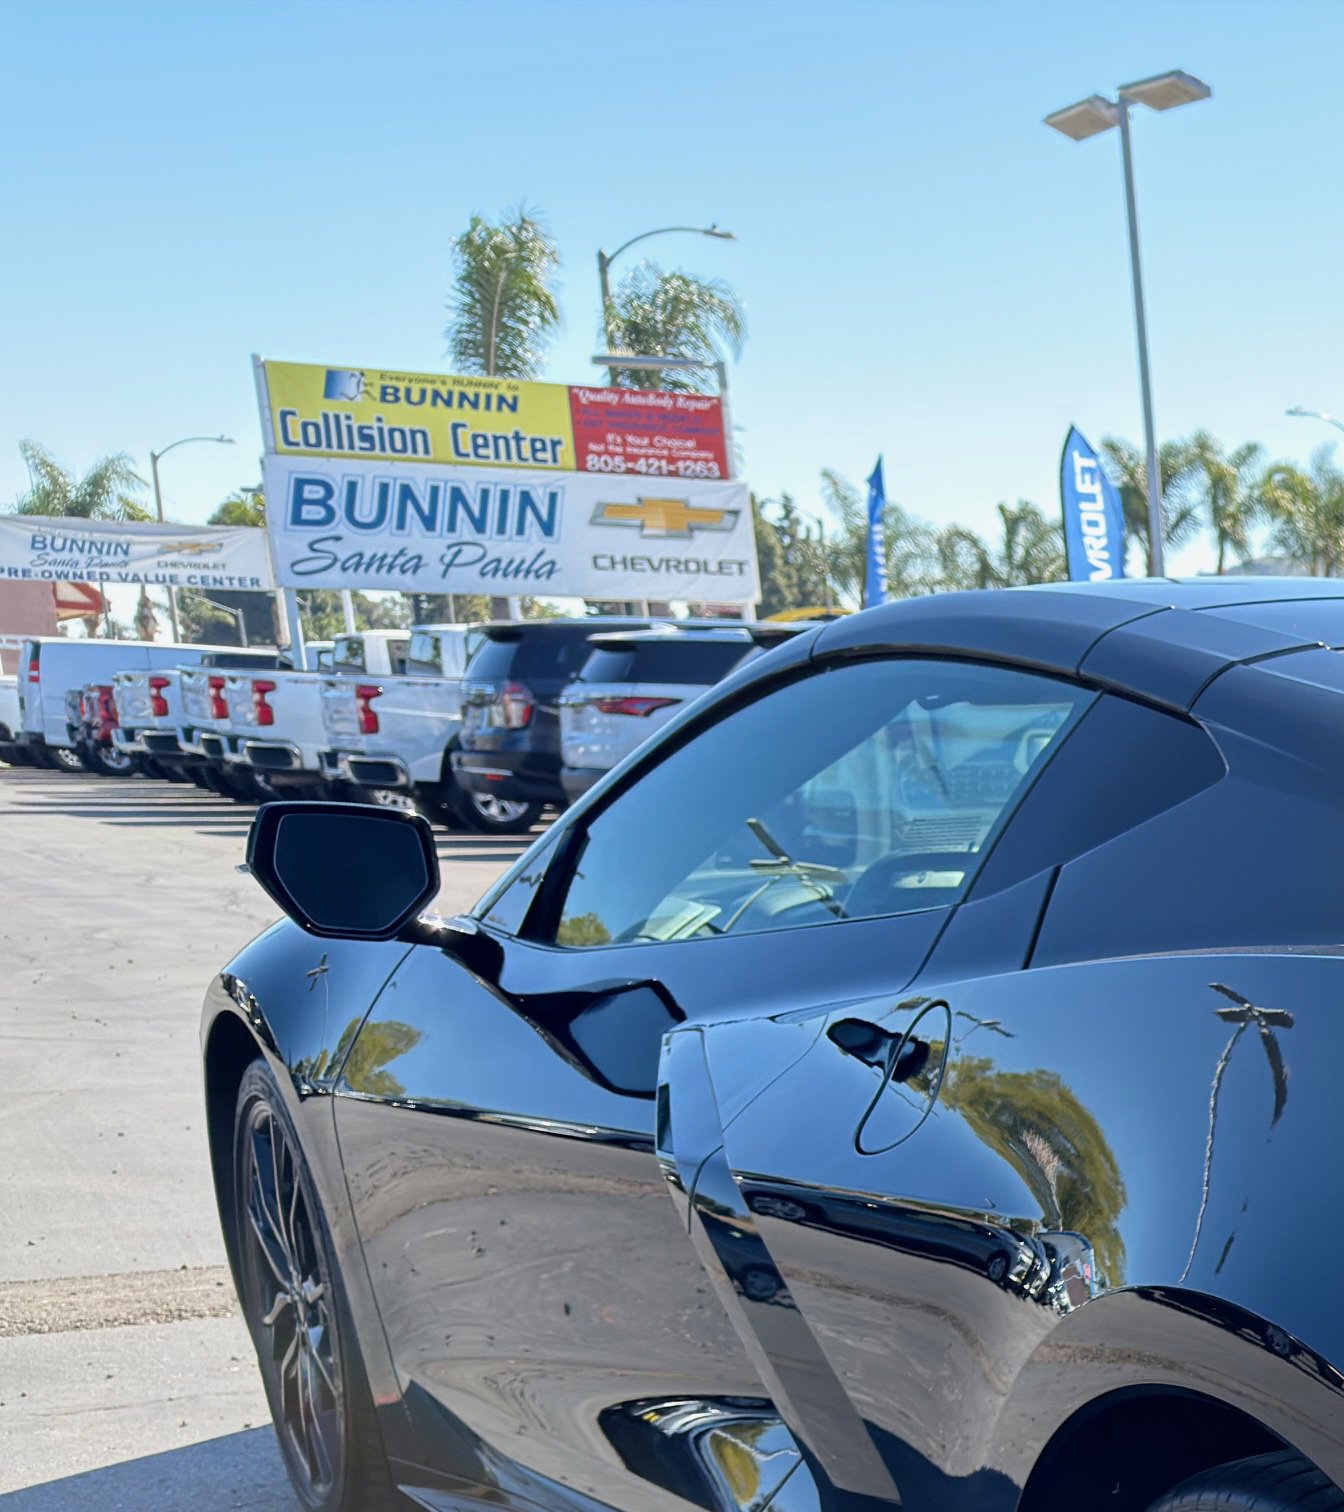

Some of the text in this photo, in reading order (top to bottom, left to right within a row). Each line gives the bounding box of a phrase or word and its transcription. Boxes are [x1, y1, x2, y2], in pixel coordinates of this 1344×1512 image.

[380, 384, 519, 413] BUNNIN
[279, 408, 564, 465] Collision Center
[288, 475, 559, 539] BUNNIN
[31, 534, 131, 557] BUNNIN
[30, 553, 80, 568] Santa
[157, 560, 227, 571] CHEVROLET
[289, 536, 562, 581] Santa Paula
[592, 555, 748, 578] CHEVROLET
[117, 572, 181, 585] VALUE
[187, 574, 261, 588] CENTER
